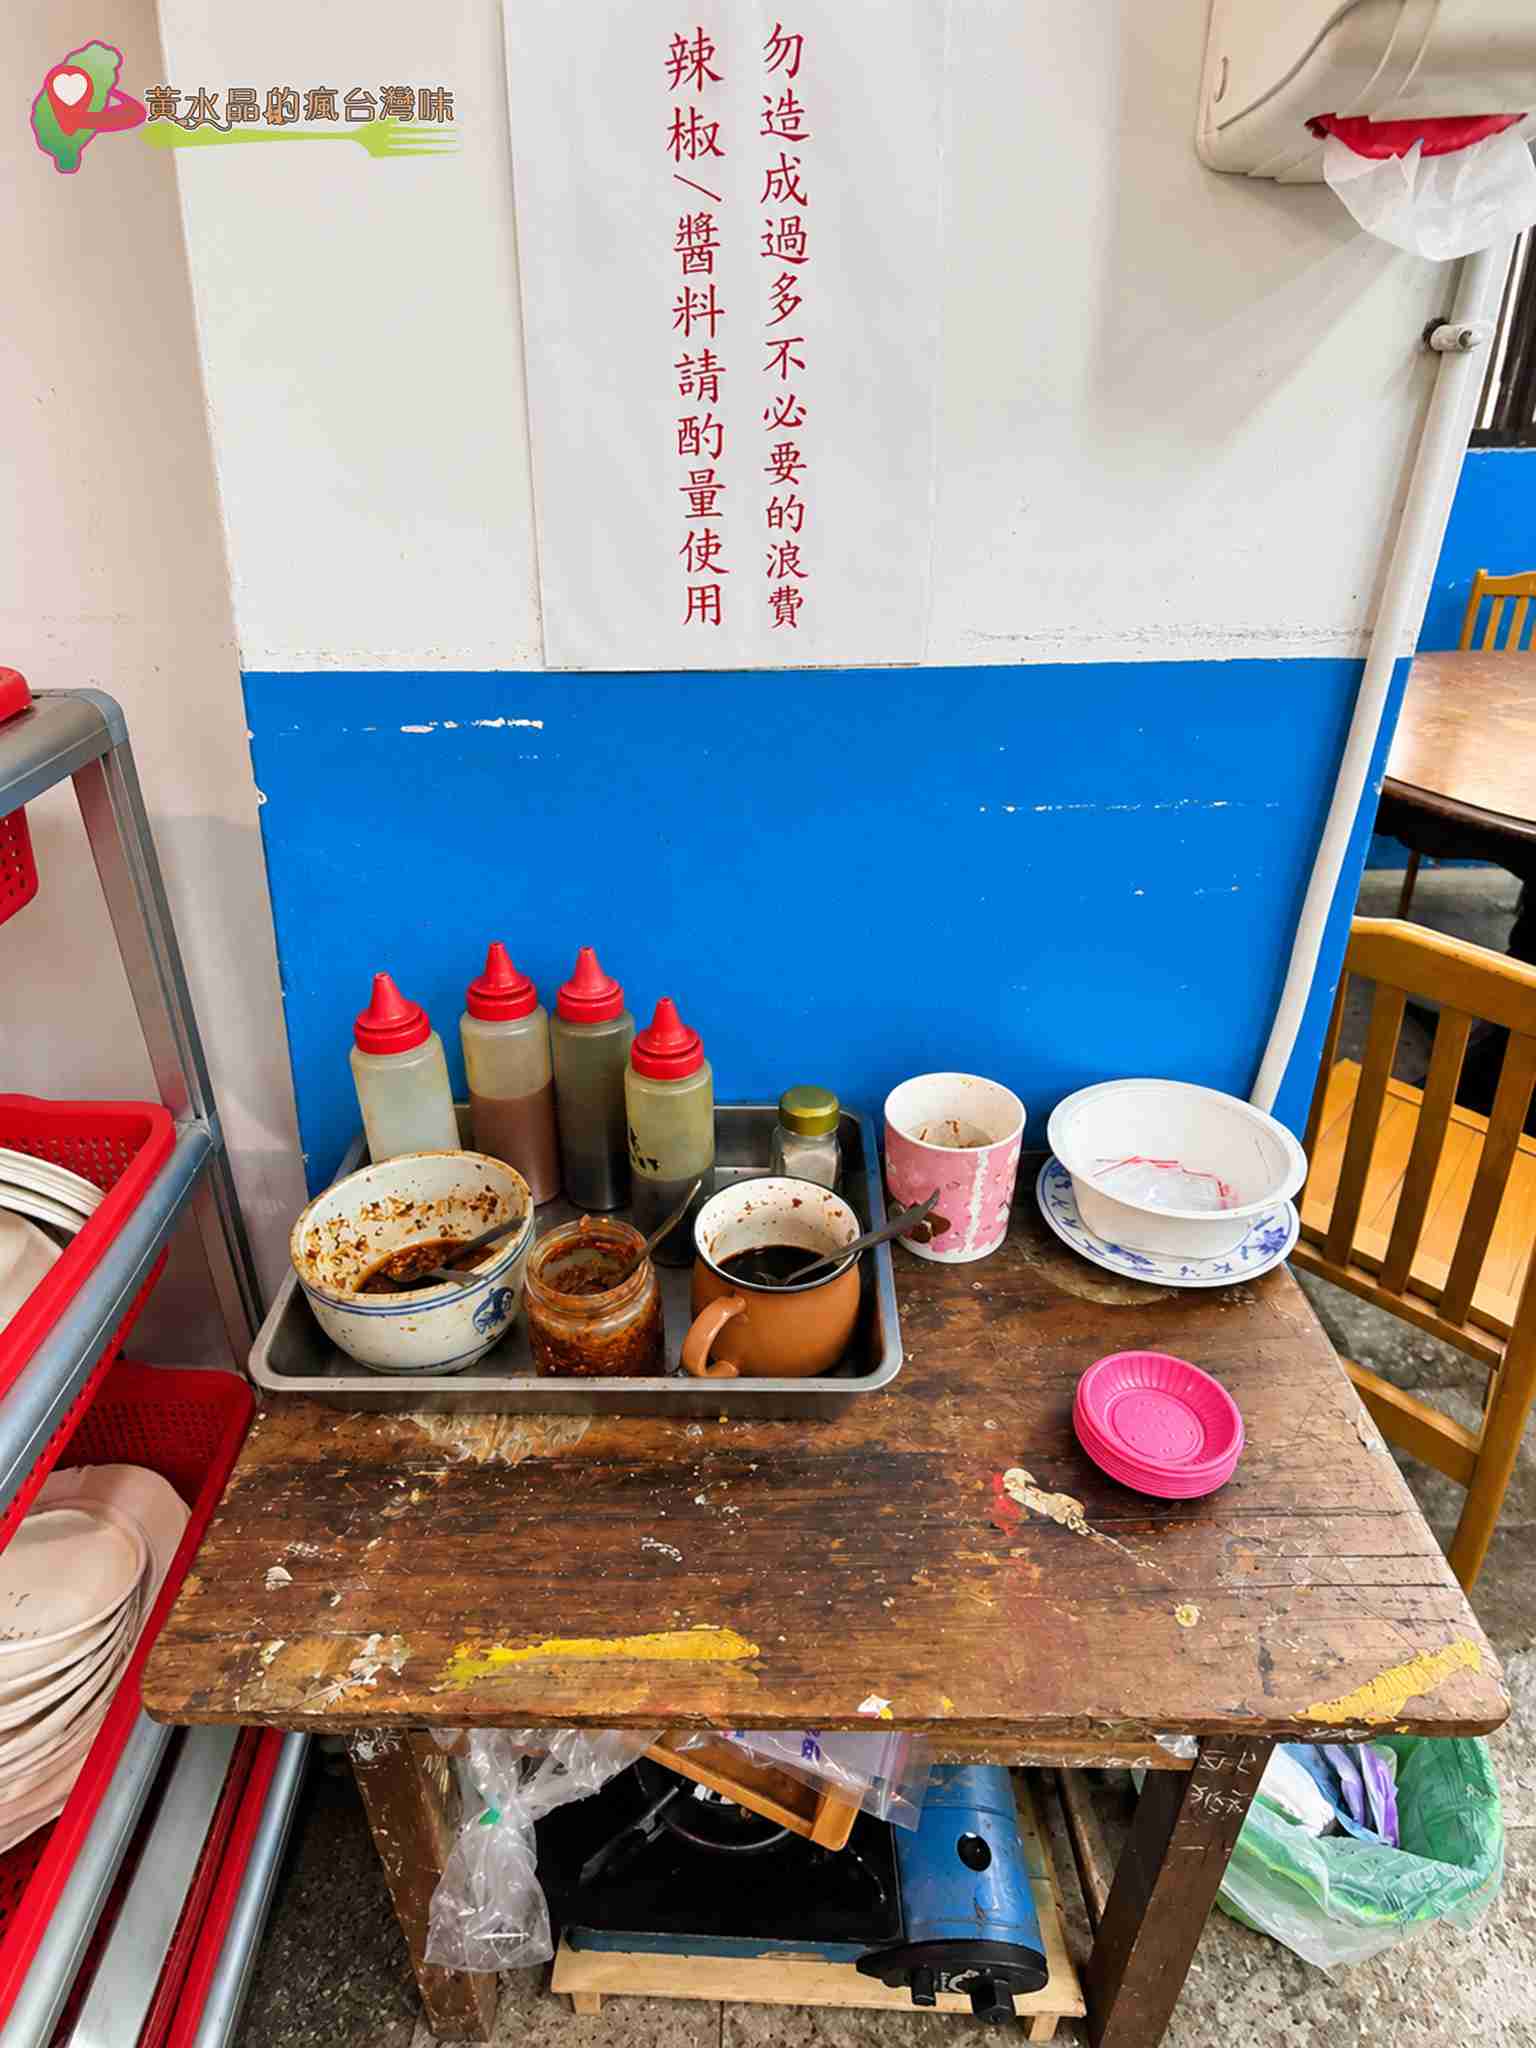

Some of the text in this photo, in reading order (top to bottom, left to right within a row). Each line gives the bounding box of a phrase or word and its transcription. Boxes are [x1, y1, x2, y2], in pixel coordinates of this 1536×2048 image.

[759, 22, 810, 629] 勿造成過多不必要的浪費
